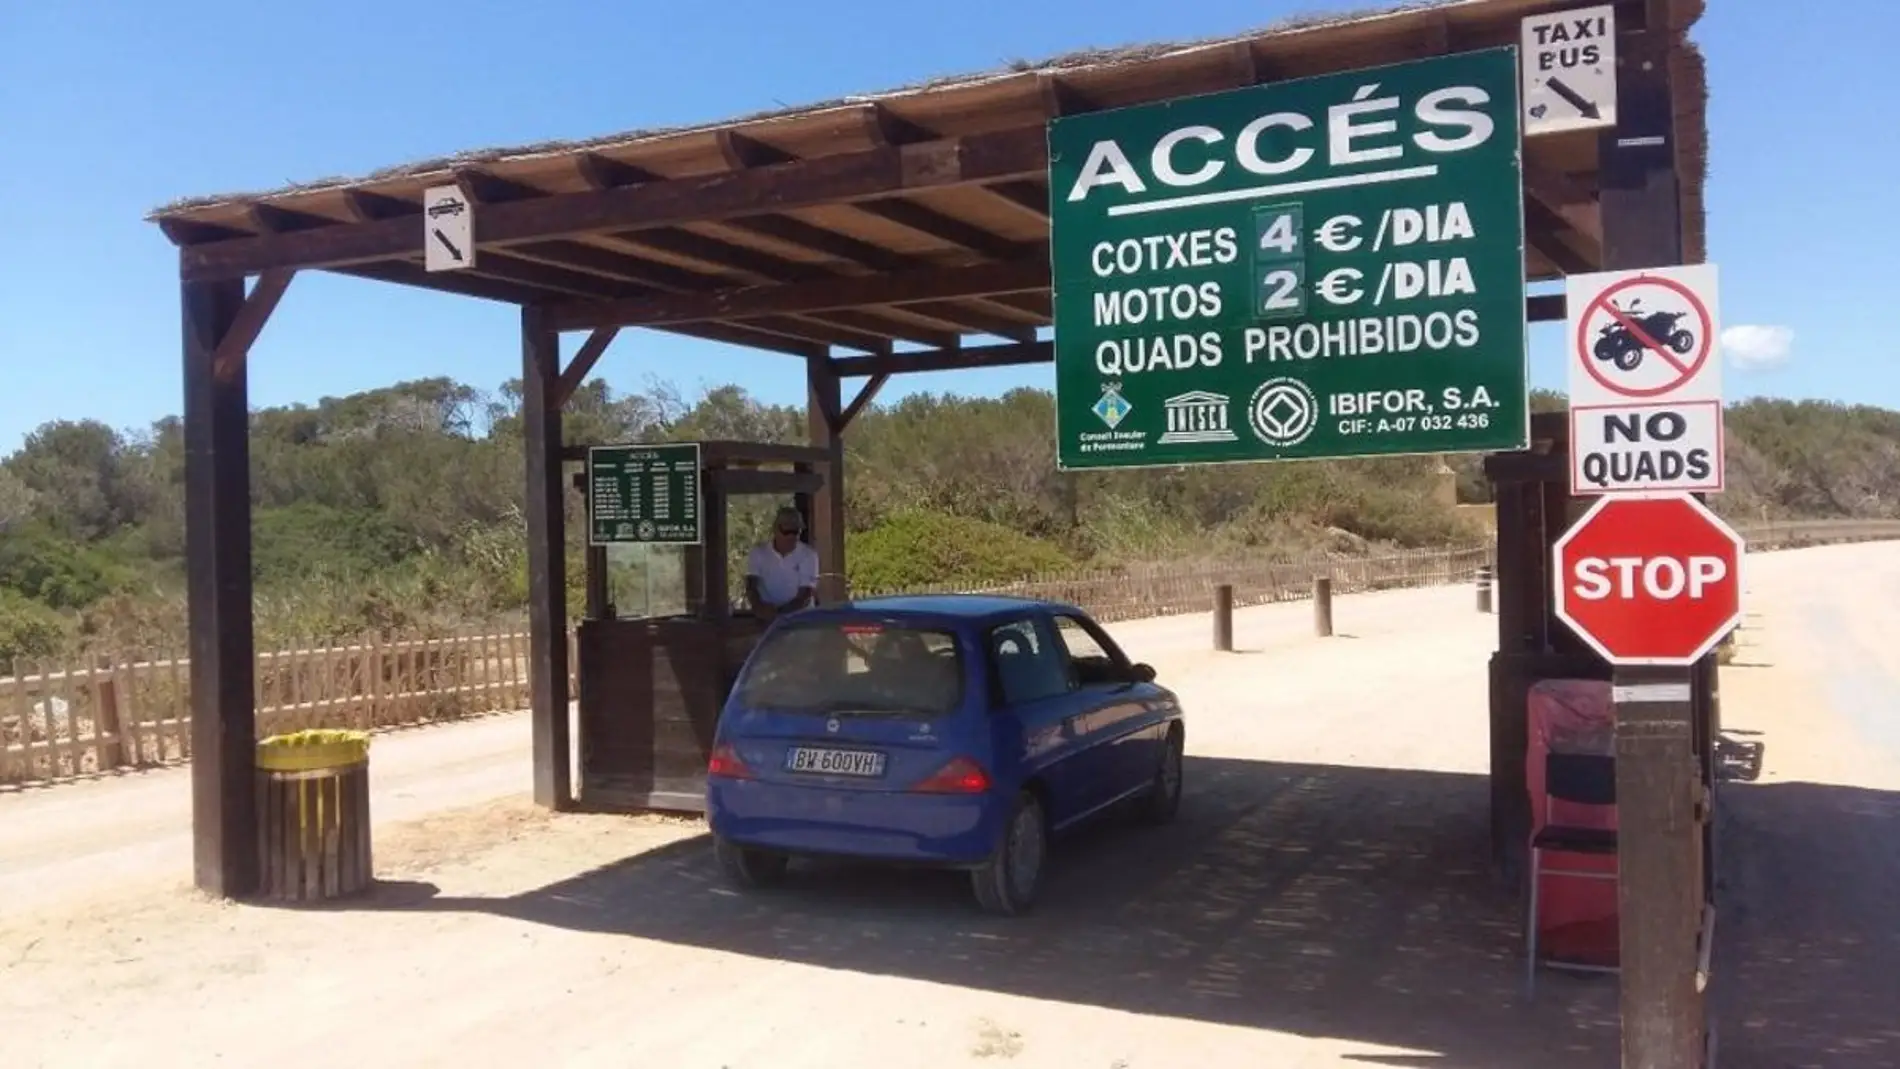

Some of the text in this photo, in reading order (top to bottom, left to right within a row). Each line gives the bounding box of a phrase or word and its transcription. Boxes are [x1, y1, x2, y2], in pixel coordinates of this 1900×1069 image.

[1532, 16, 1606, 45] TAXI
[1539, 44, 1600, 71] BUS
[1067, 83, 1495, 201] ACCÉS
[1091, 227, 1238, 277] COTXES
[1259, 214, 1298, 253] 4
[1094, 281, 1222, 326] MOTOS
[1263, 270, 1300, 310] 2
[1095, 309, 1480, 376] QUADS PROHIBIDOS
[1167, 403, 1228, 432] UNESCO
[1329, 385, 1501, 415] IBIFOR, S.A.
[1338, 413, 1490, 434] CIF: A-07 032 436
[1603, 411, 1687, 443] NO
[1583, 448, 1711, 486] QUADS
[1572, 556, 1727, 600] STOP
